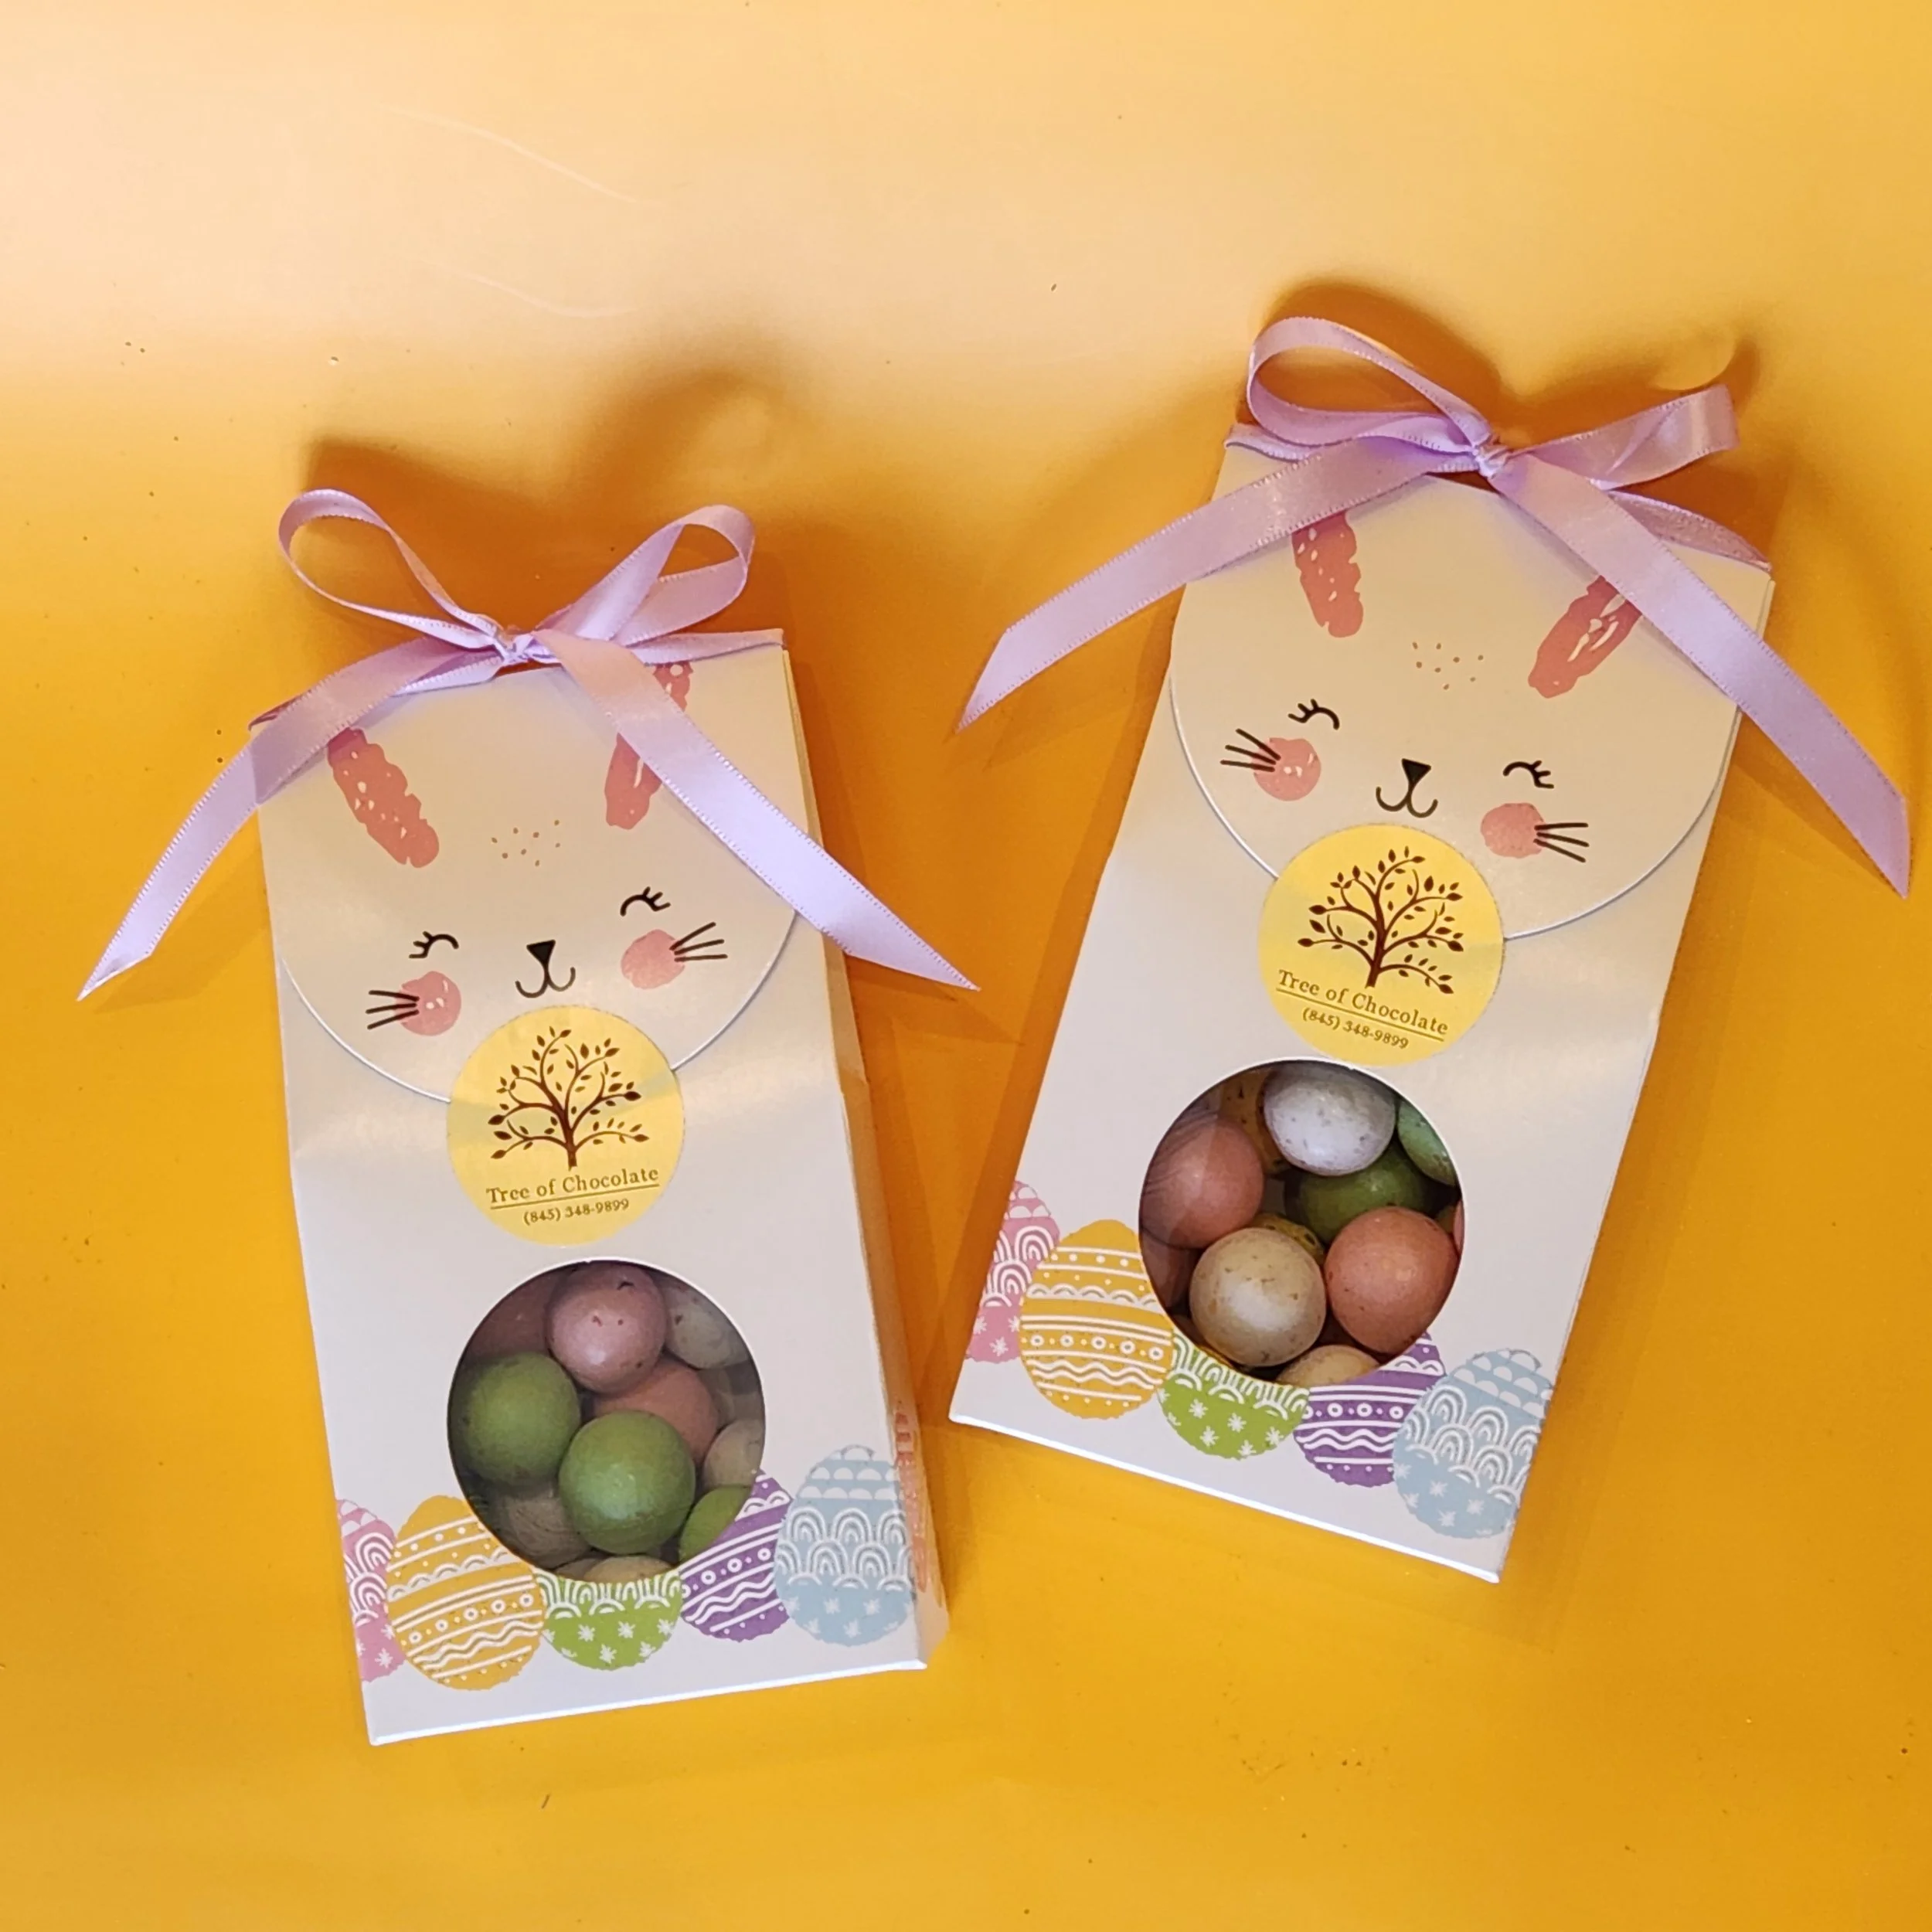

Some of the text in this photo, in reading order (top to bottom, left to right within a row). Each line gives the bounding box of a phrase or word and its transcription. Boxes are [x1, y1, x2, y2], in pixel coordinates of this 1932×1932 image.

[1279, 969, 1448, 1035] Tree of Chocolate
[1303, 1007, 1409, 1049] (845) 348-9899
[486, 1168, 658, 1203] Tree of Chocolate
[523, 1198, 629, 1226] (845) 348-9899
